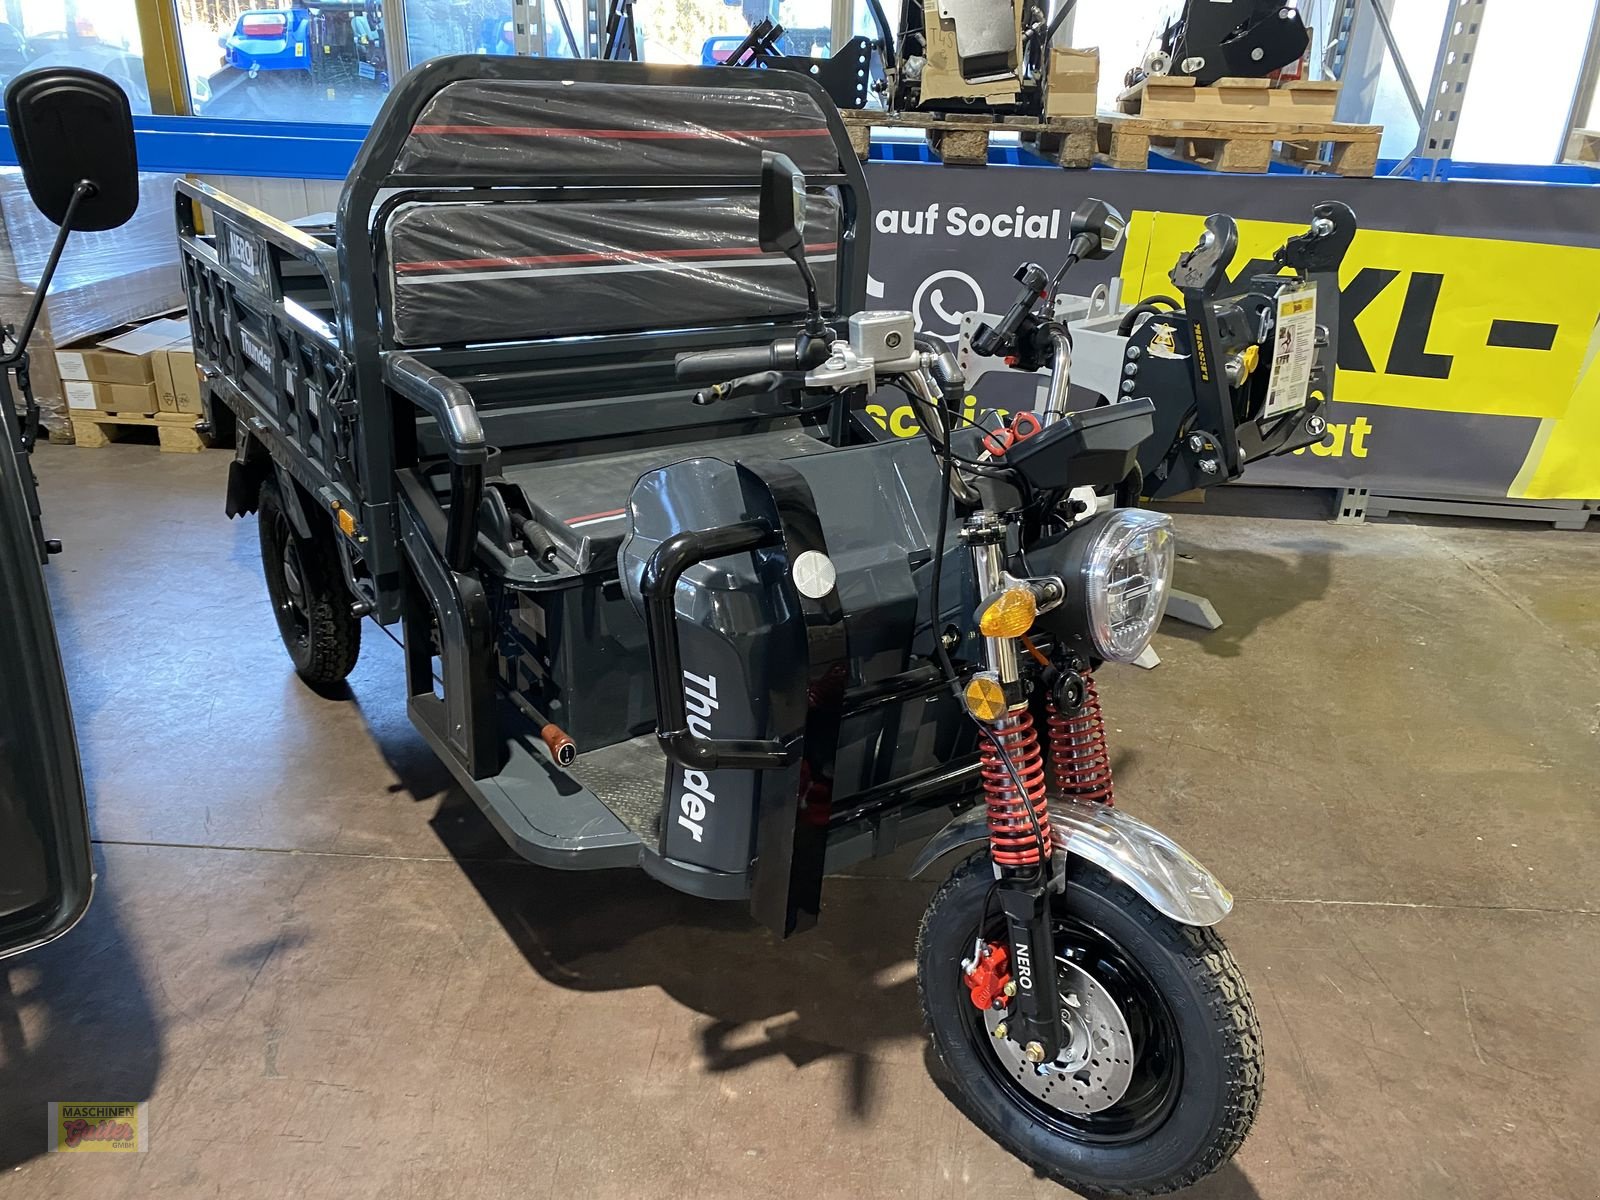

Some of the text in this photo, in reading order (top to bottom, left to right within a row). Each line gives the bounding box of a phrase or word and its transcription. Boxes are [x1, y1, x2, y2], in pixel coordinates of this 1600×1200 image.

[875, 203, 939, 235] auf
[946, 205, 1061, 240] Social
[229, 231, 253, 266] NERO
[240, 331, 272, 374] Thunder
[677, 670, 719, 843] Thuder
[1015, 942, 1033, 990] NERO
